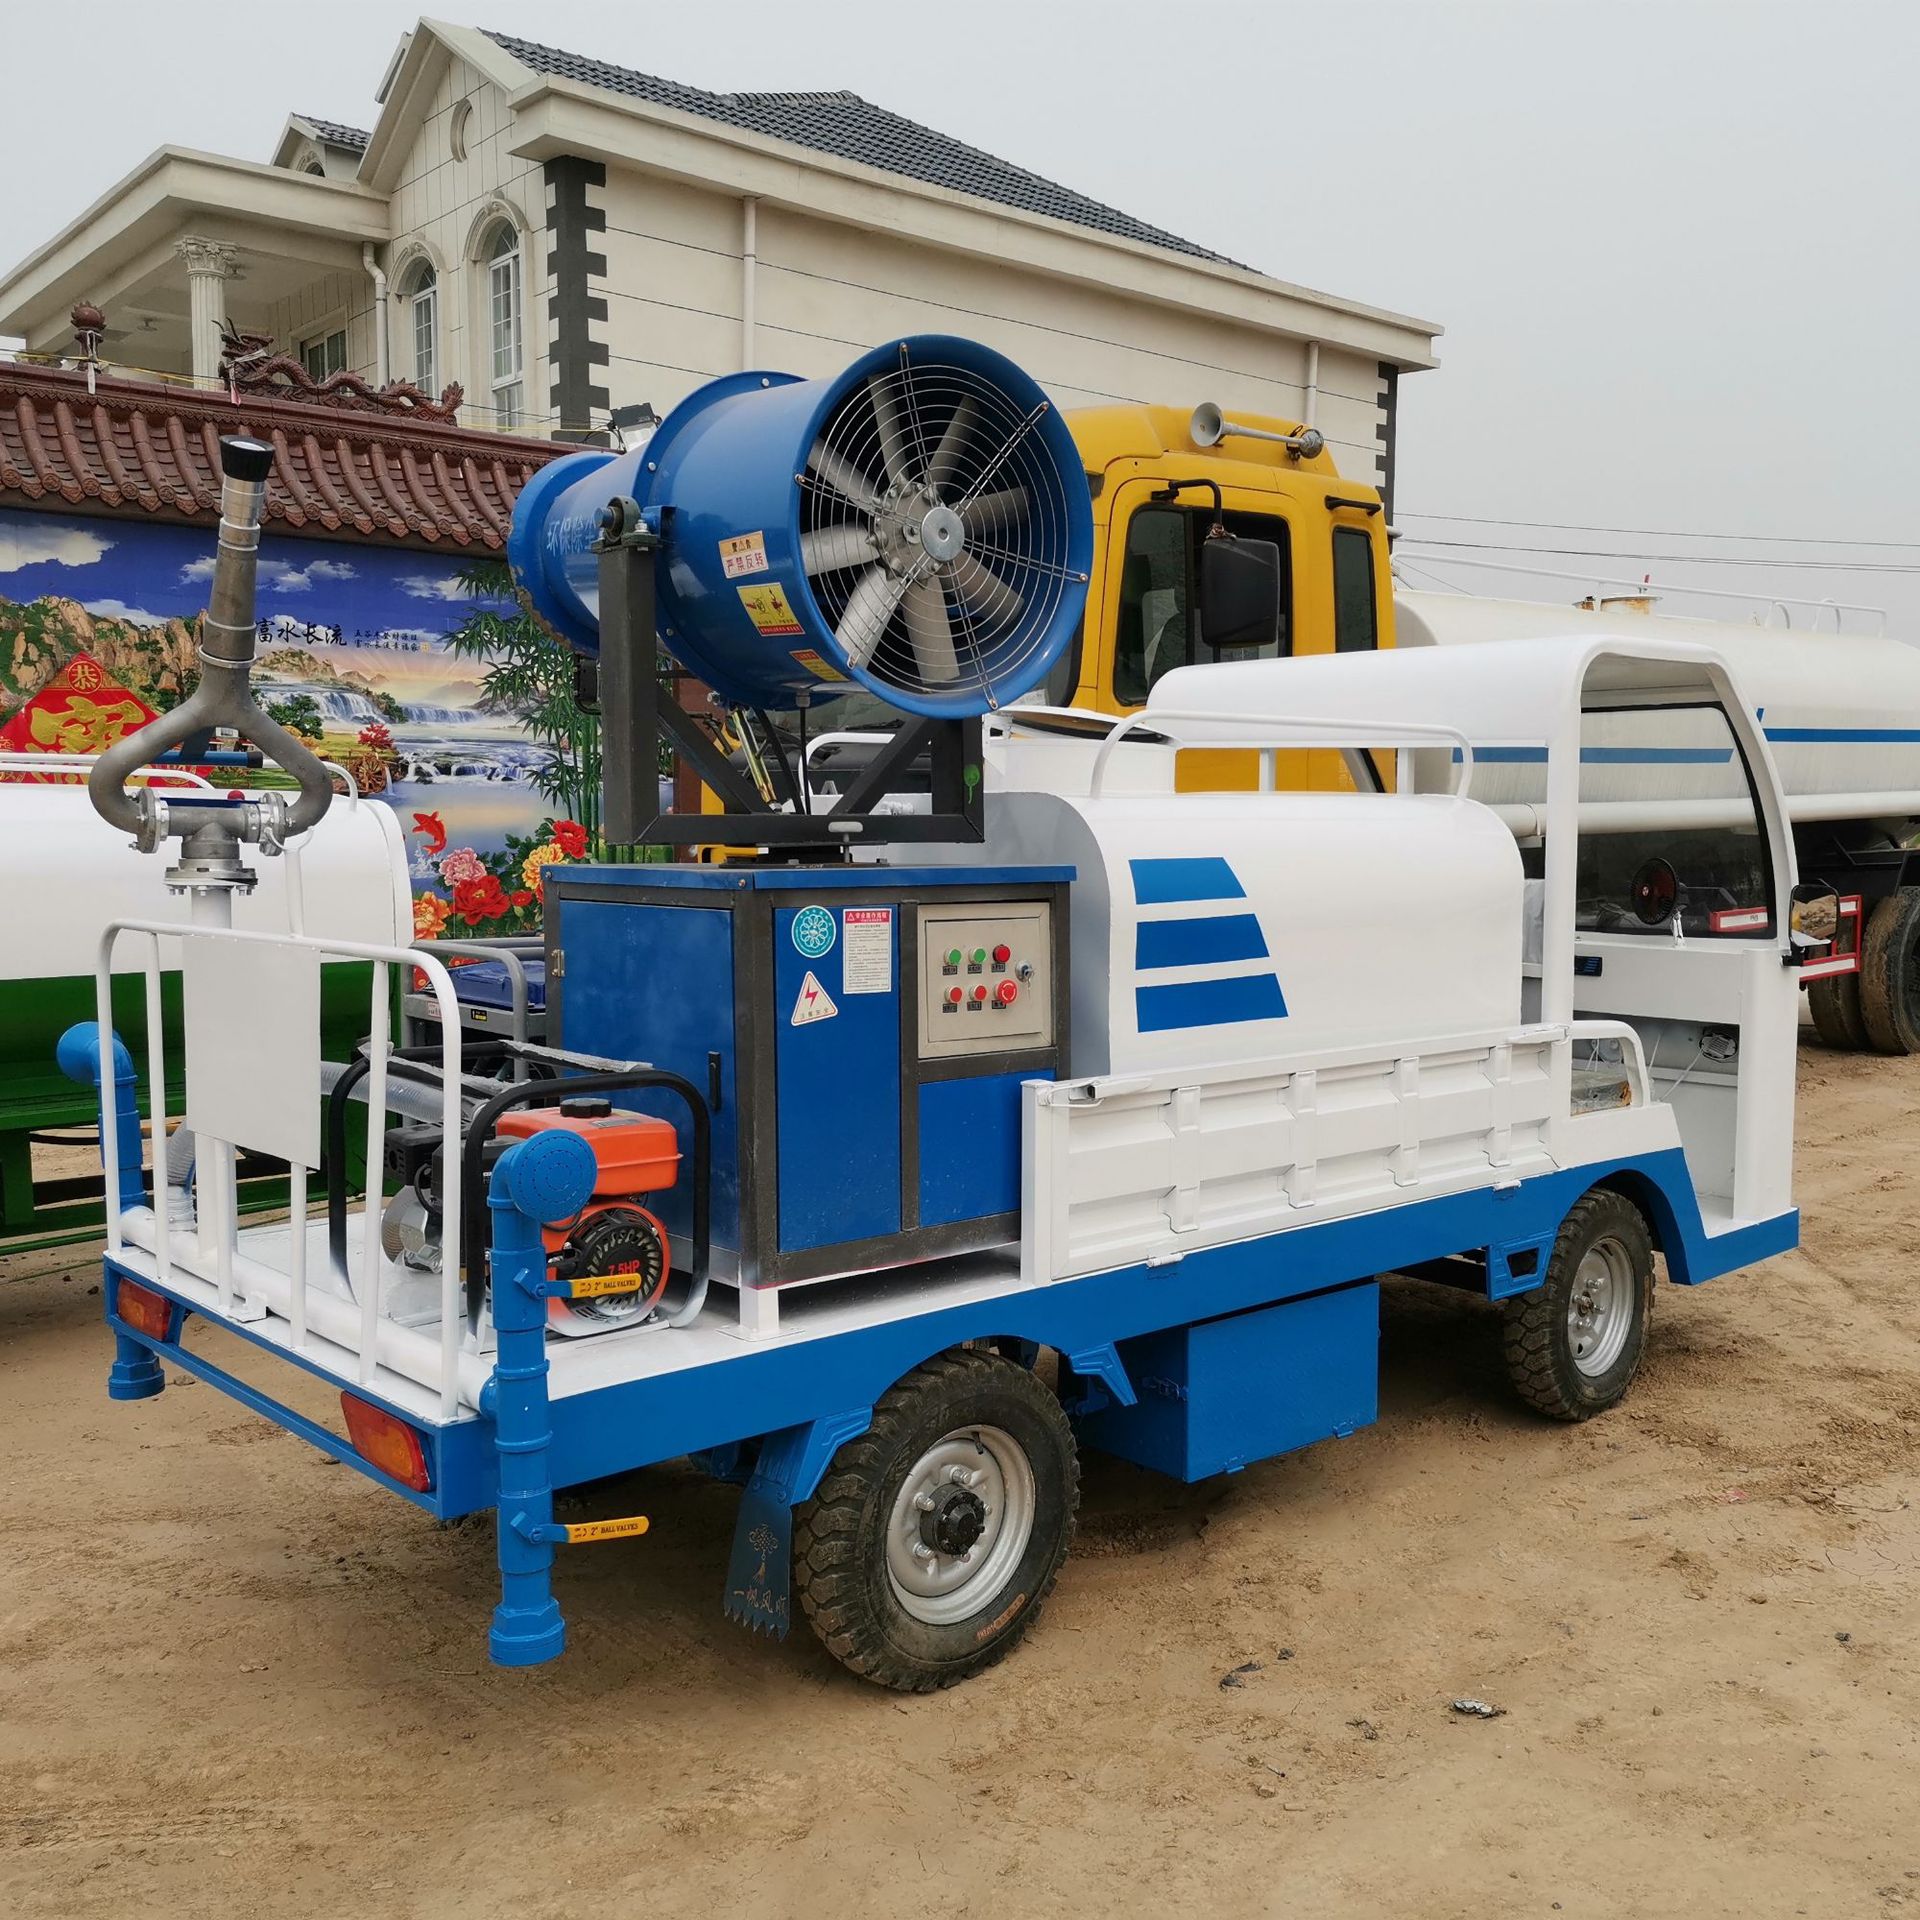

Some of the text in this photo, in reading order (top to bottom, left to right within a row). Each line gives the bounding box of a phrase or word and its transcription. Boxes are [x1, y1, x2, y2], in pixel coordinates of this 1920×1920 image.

[726, 552, 765, 573] 严禁反转
[255, 617, 348, 647] 富水长流
[72, 664, 101, 691] 恭
[608, 1260, 640, 1277] 75HP
[601, 1525, 615, 1534] BALL
